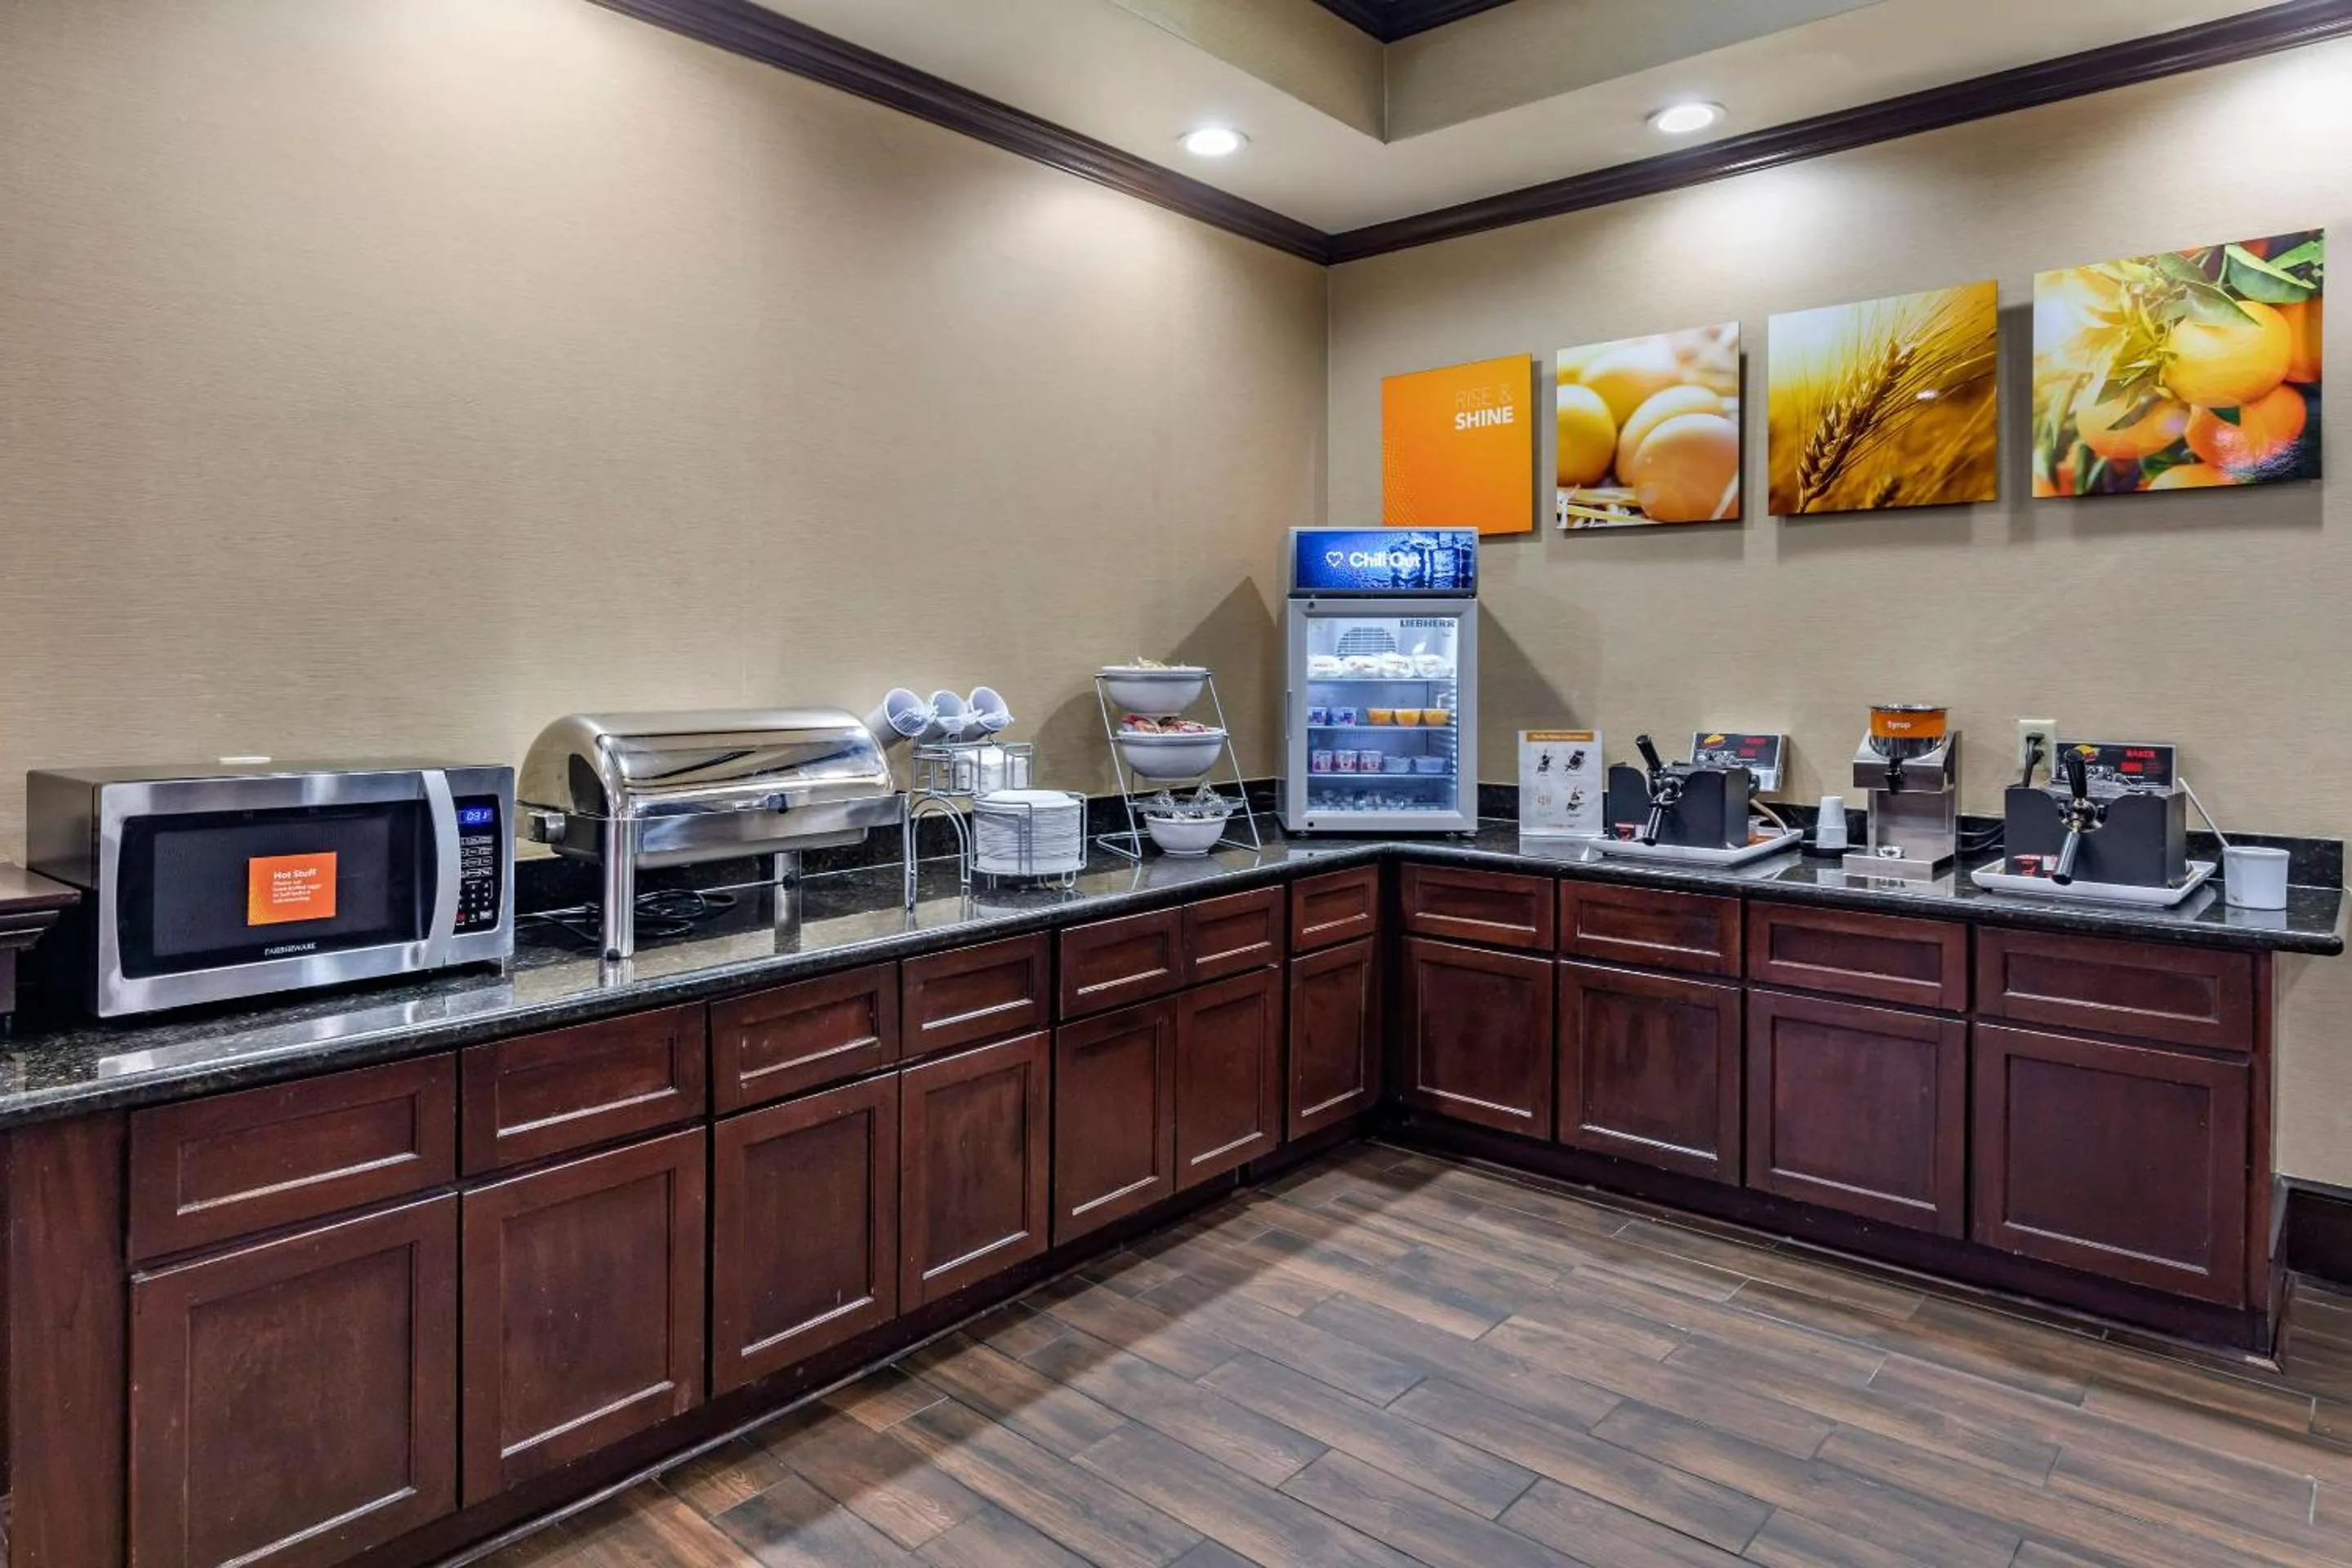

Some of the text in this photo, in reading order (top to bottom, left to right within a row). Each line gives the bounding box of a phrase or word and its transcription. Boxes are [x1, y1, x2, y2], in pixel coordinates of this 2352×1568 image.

[1455, 383, 1514, 409] RISE &
[1454, 405, 1514, 431] SHINE
[1348, 550, 1421, 569] Chill Out
[274, 867, 318, 880] Hot Stuff
